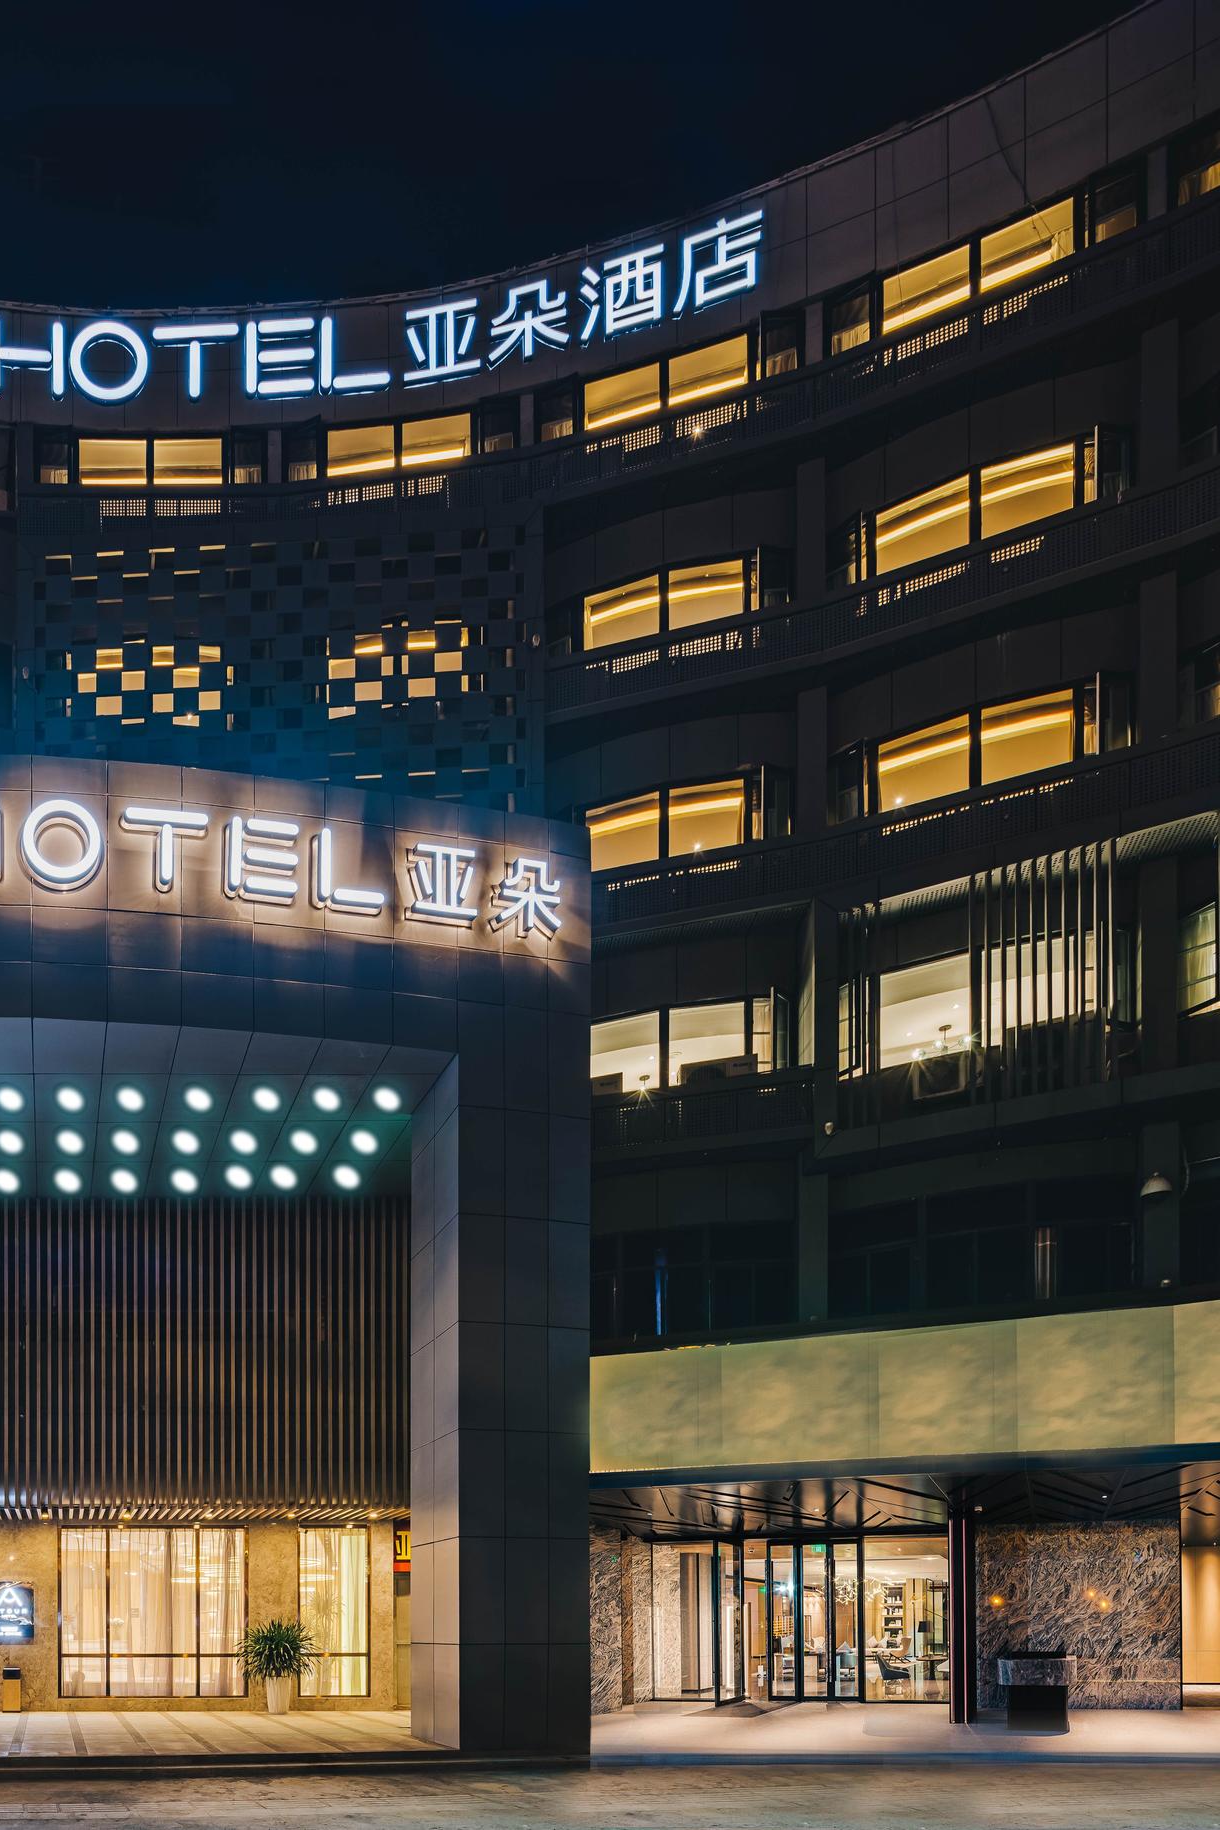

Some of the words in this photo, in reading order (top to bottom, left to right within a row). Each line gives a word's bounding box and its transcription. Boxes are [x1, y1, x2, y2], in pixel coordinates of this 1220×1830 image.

[402, 209, 764, 383] 亚朵酒店
[402, 842, 564, 938] 亚朵
